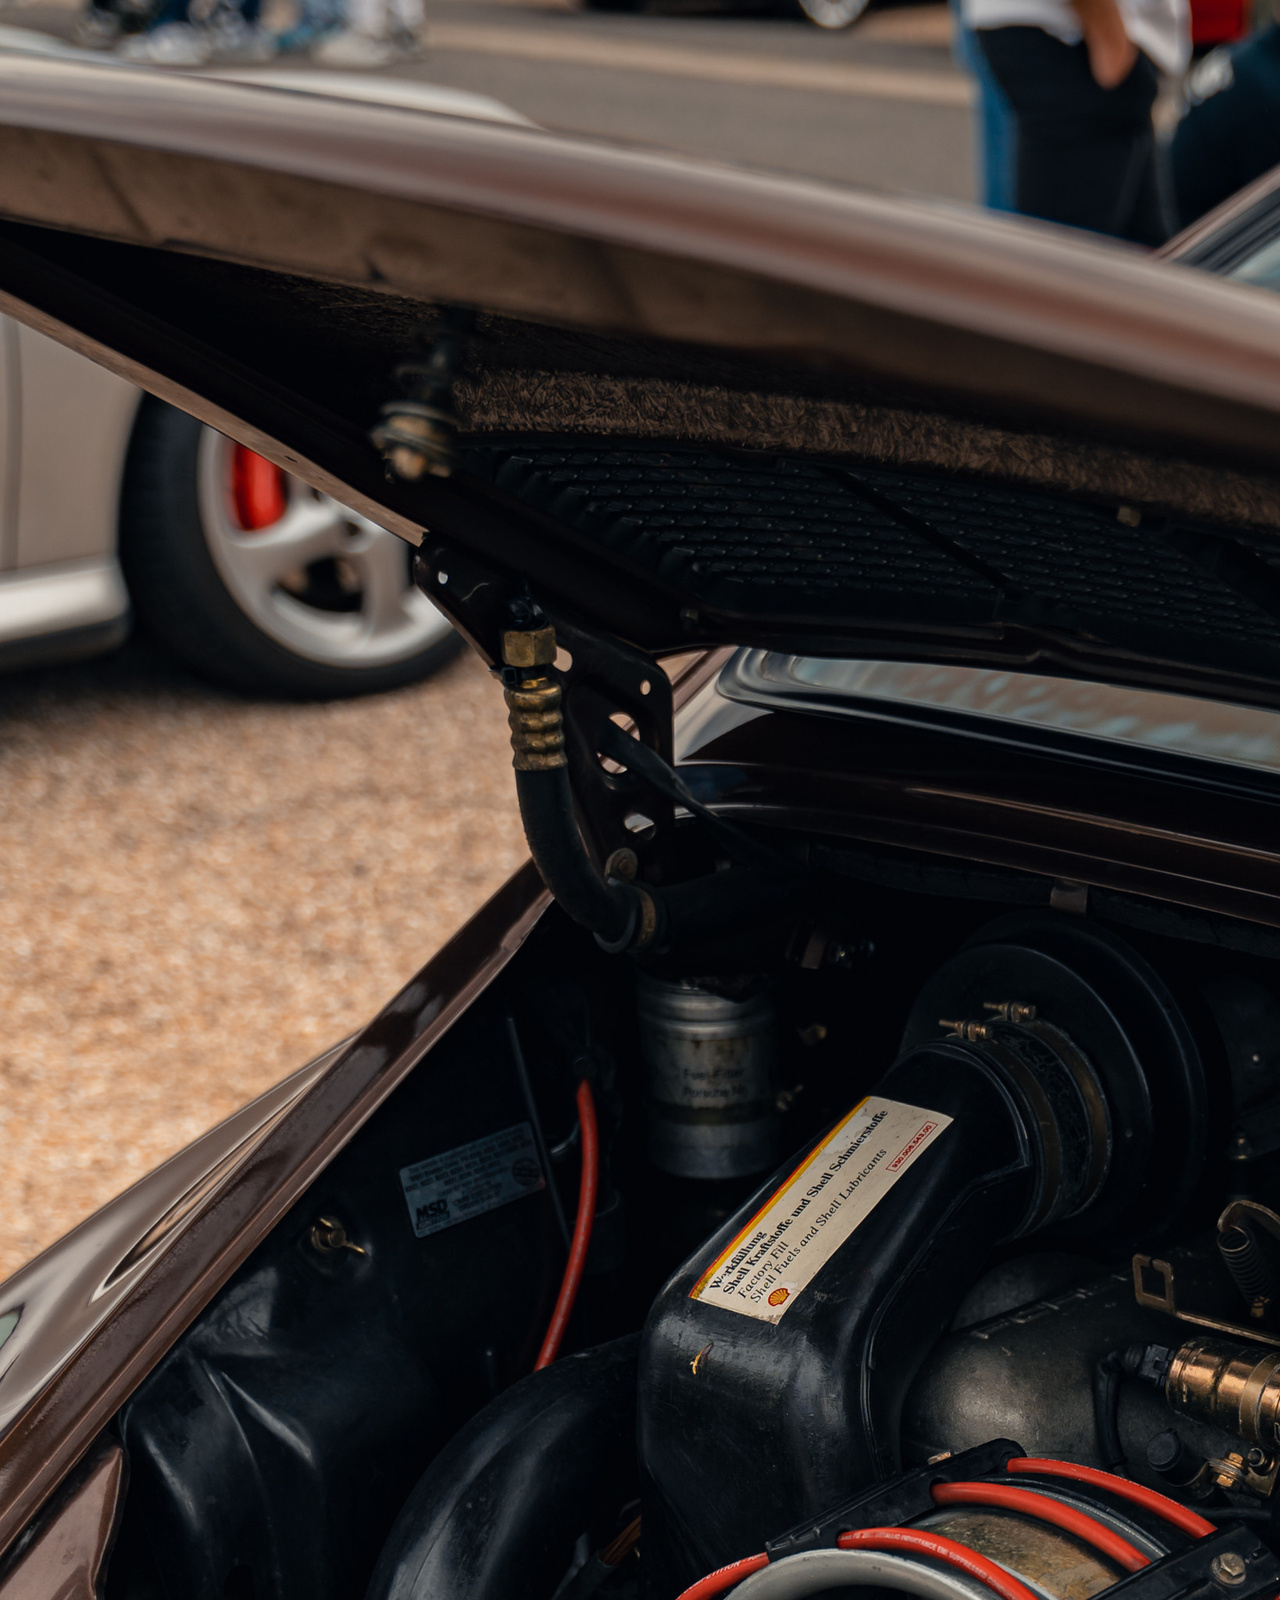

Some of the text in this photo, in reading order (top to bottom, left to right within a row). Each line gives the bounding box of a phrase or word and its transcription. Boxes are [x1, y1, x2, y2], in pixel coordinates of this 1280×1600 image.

[416, 1199, 449, 1221] MSD
[723, 1111, 887, 1294] Shell Kraftstoffe und Shell Schmierstoffe
[750, 1149, 886, 1303] Shell Fuels and Shell Lubricants
[738, 1241, 788, 1298] Factory Fill
